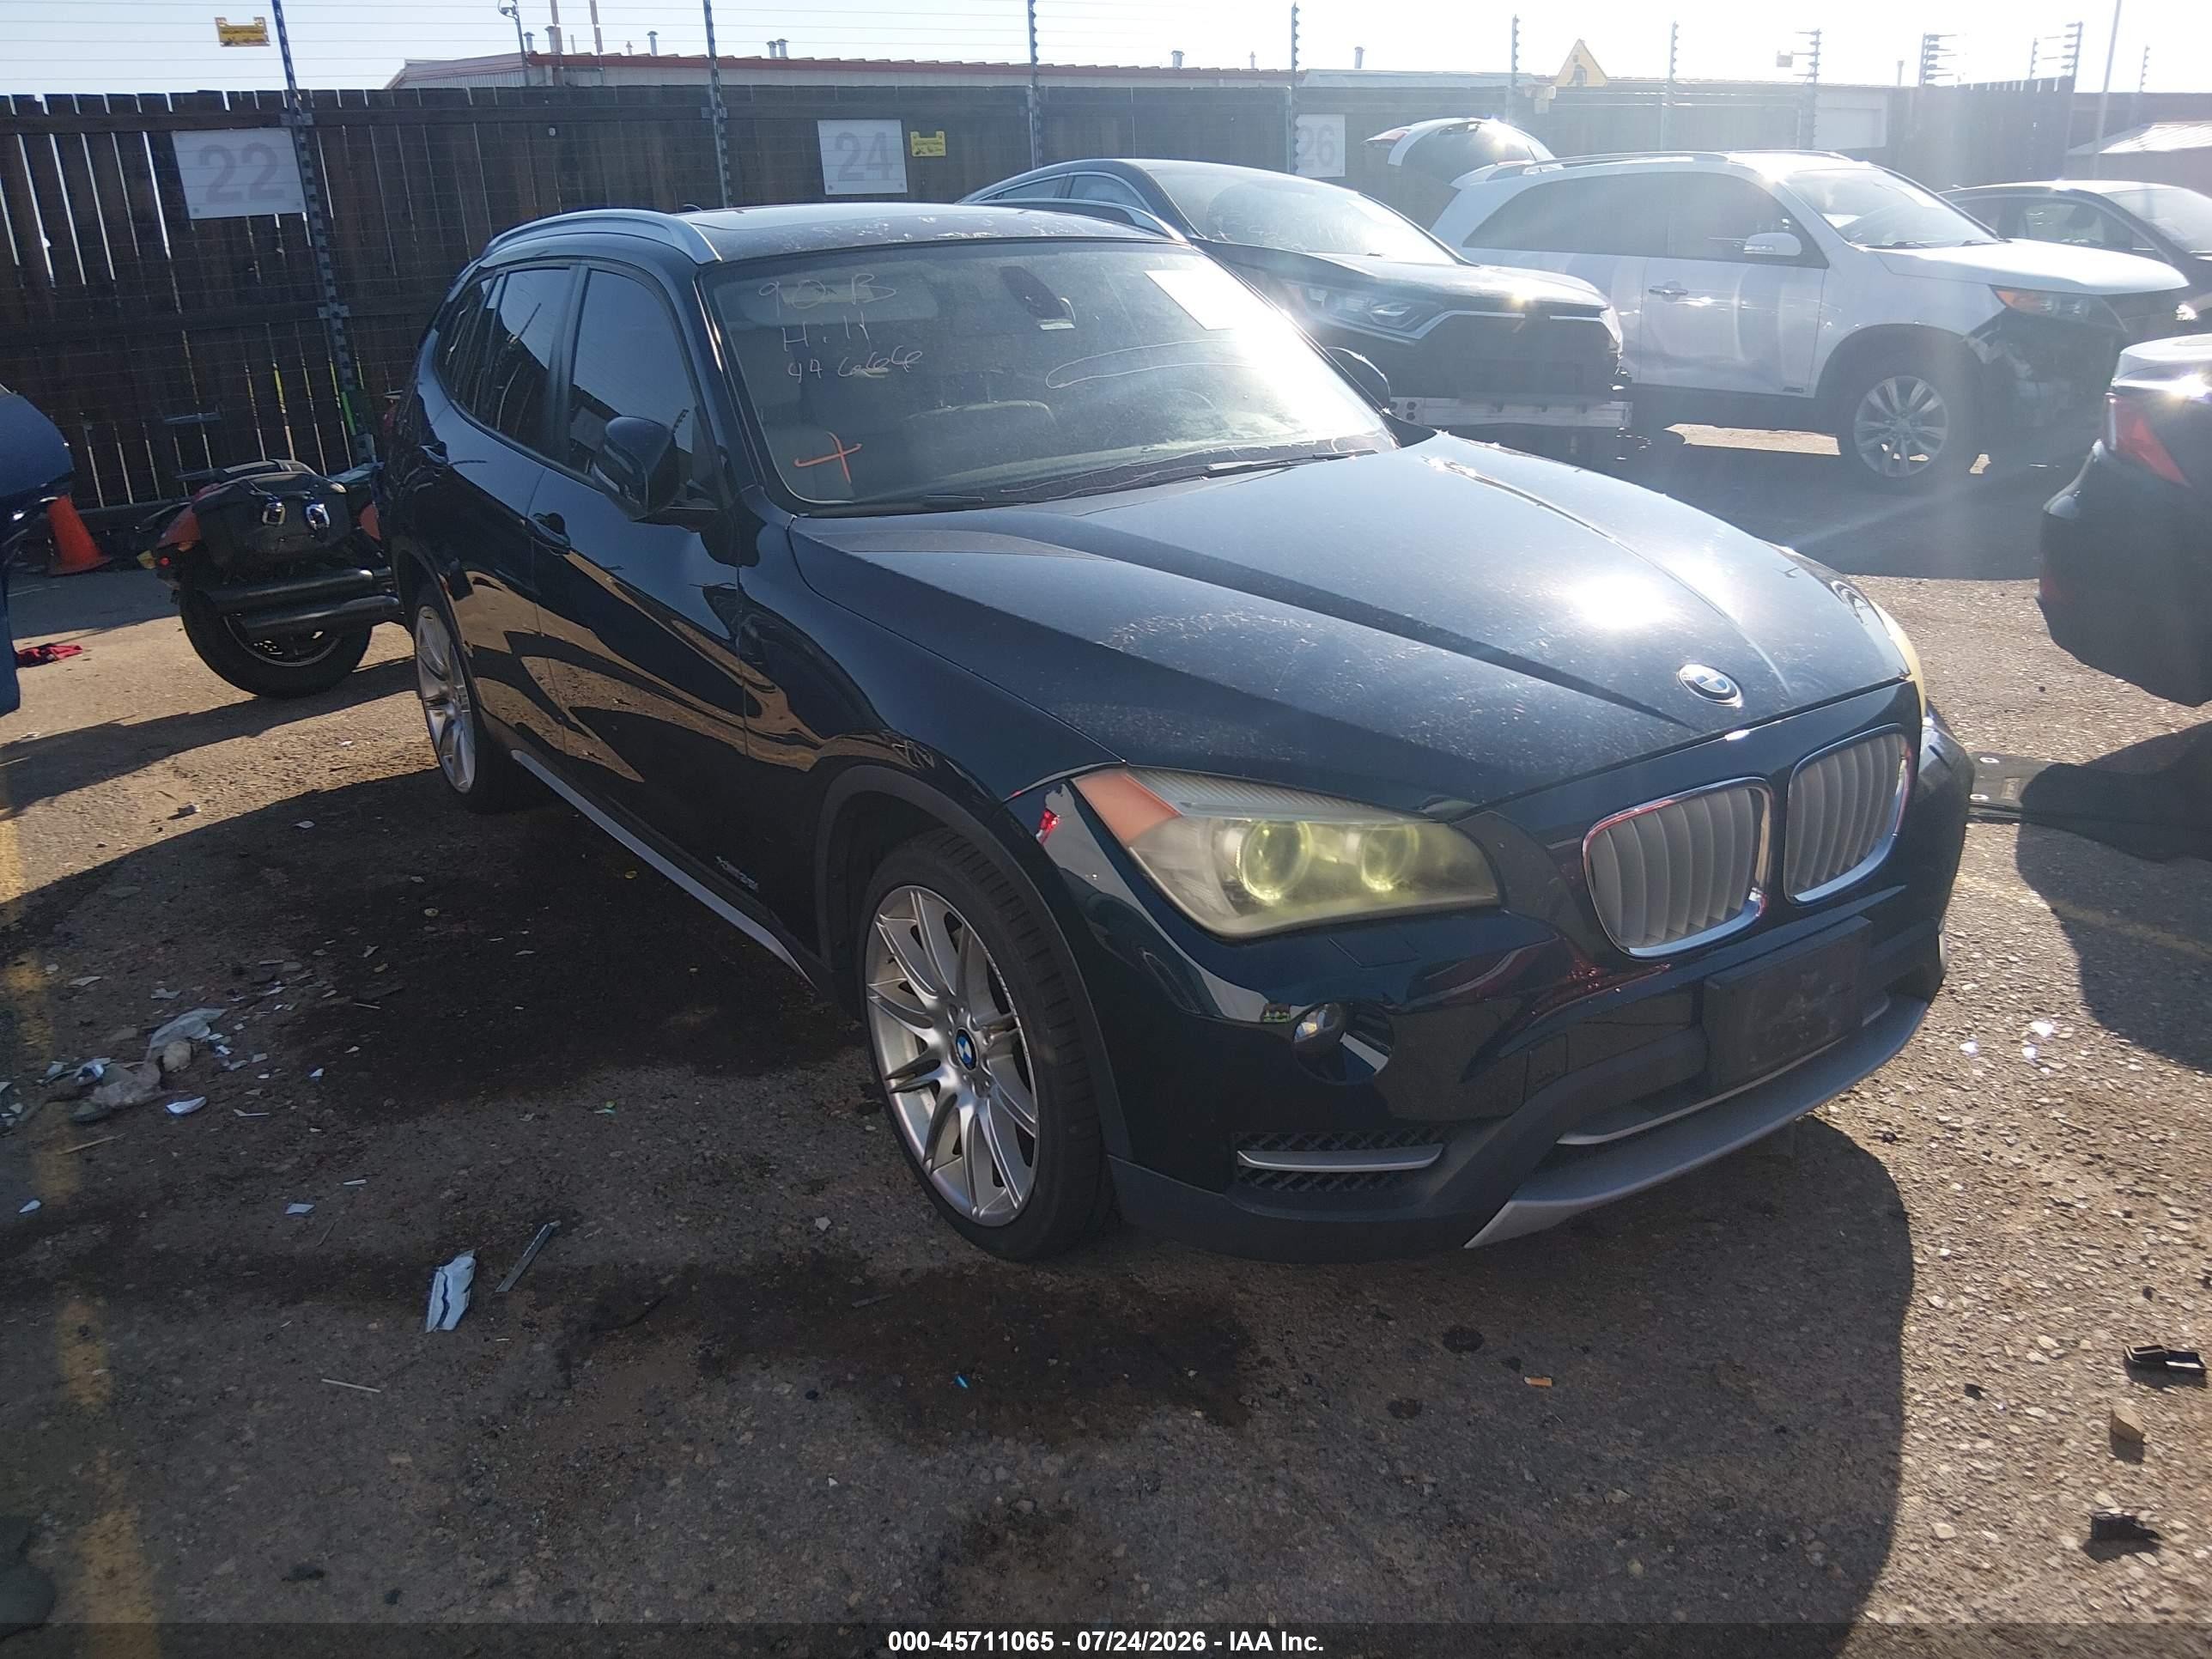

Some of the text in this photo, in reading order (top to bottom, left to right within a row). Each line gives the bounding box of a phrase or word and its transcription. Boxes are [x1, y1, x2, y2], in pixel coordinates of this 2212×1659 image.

[835, 131, 893, 181] 24
[1297, 125, 1335, 167] 26
[198, 143, 286, 205] 22
